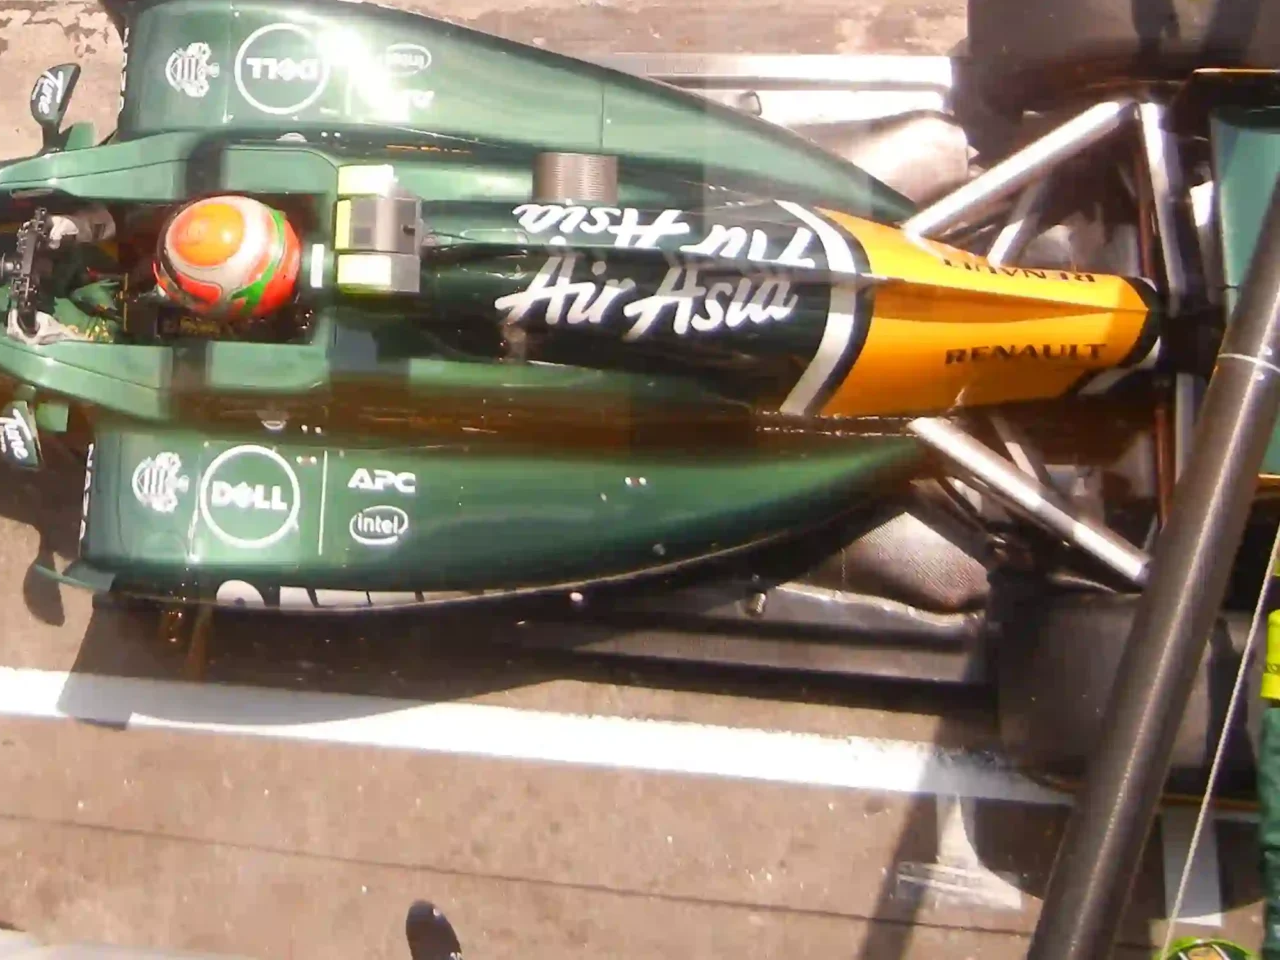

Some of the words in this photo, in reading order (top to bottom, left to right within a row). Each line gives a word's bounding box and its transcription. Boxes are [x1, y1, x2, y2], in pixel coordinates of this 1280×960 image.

[246, 56, 320, 82] DELL
[943, 258, 1096, 283] RENAULT
[944, 343, 1107, 365] RENAULT
[347, 467, 416, 493] APC
[210, 480, 288, 511] DELL
[356, 512, 400, 535] intel
